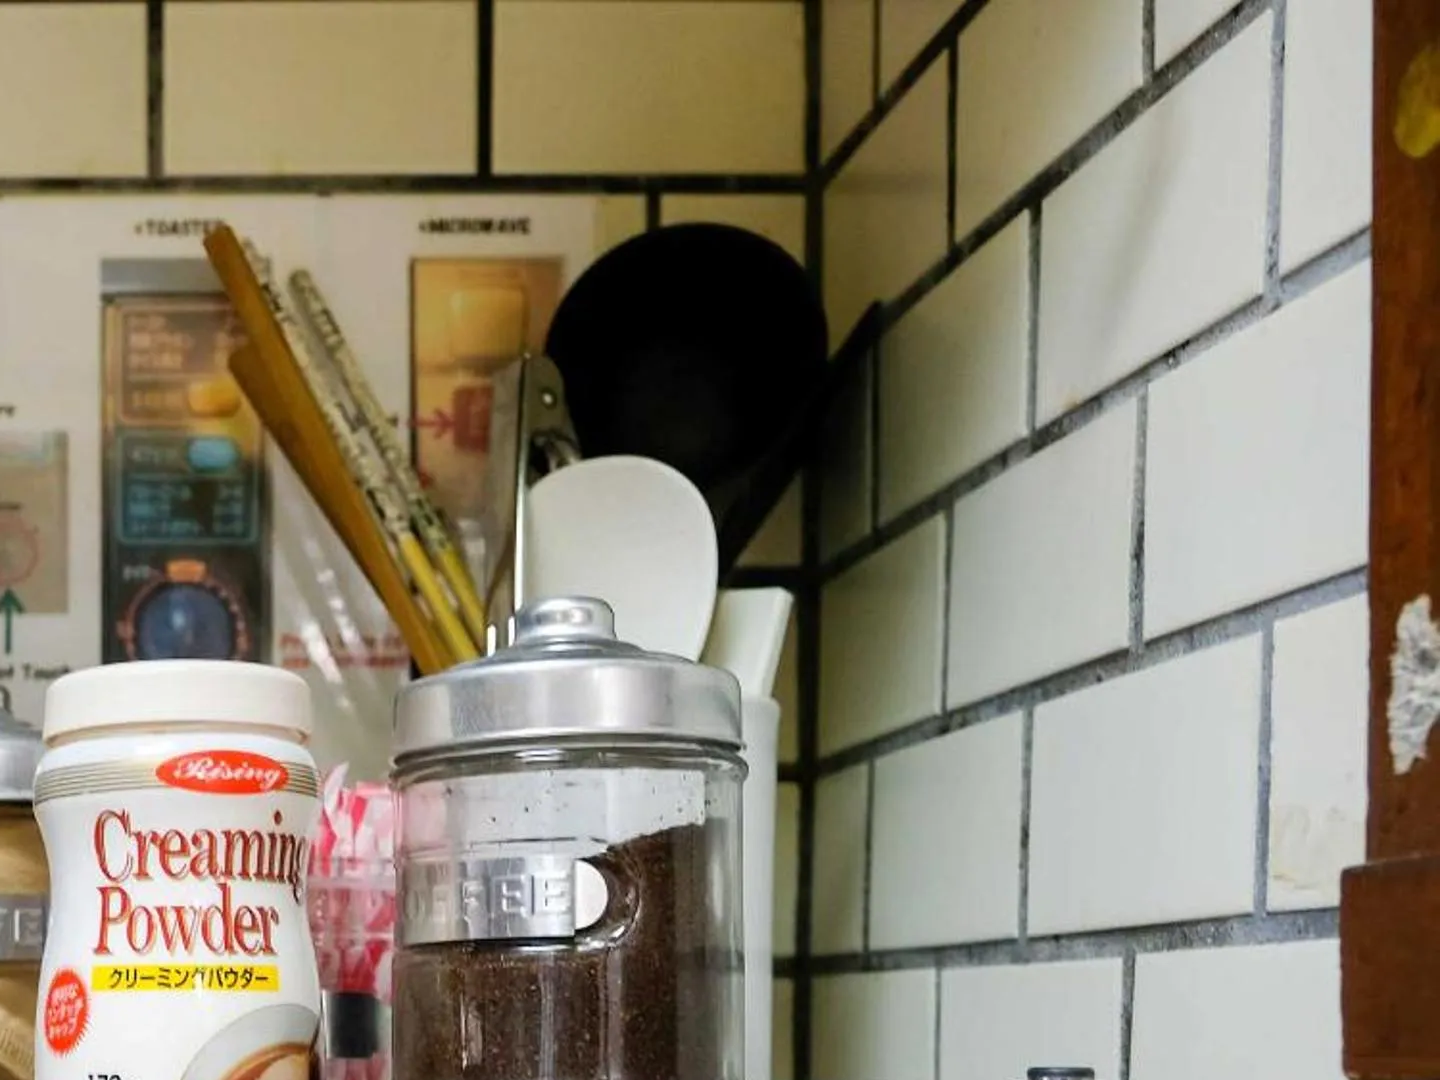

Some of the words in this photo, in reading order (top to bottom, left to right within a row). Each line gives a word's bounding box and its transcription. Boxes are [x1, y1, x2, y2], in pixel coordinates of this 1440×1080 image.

[145, 217, 217, 237] TOASTE
[92, 882, 280, 957] Powder
[109, 966, 269, 989] クリーミングパウダー
